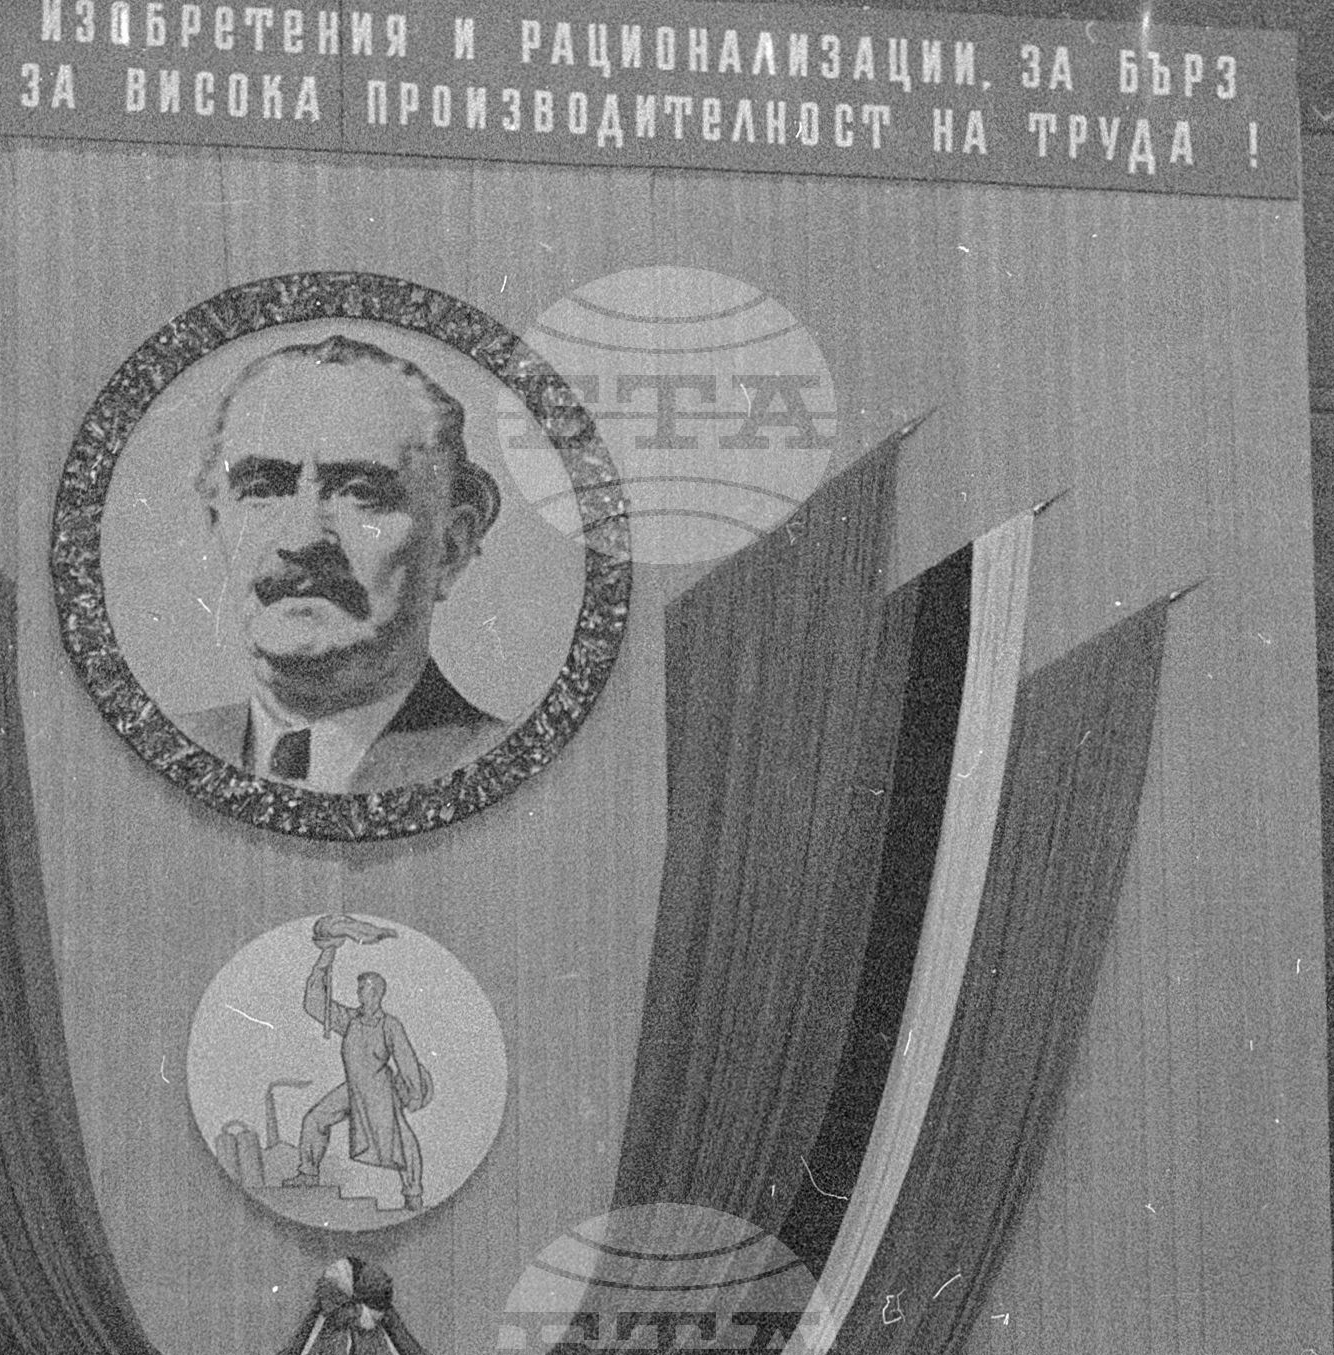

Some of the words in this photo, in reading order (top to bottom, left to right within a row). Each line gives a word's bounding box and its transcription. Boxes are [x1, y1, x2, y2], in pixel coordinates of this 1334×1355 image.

[41, 0, 408, 57] ИЗОБРЕТЕНИЯ
[454, 17, 475, 60] И
[1020, 44, 1073, 91] ЗА
[1119, 49, 1237, 100] БЪРЗ
[20, 63, 76, 109] ЗА
[125, 68, 321, 122] ВИСОКА
[367, 80, 891, 149] ПРОИЗВОДИТЕЛНОСТ
[932, 109, 987, 155] НА
[1028, 113, 1194, 175] ТРУДА
